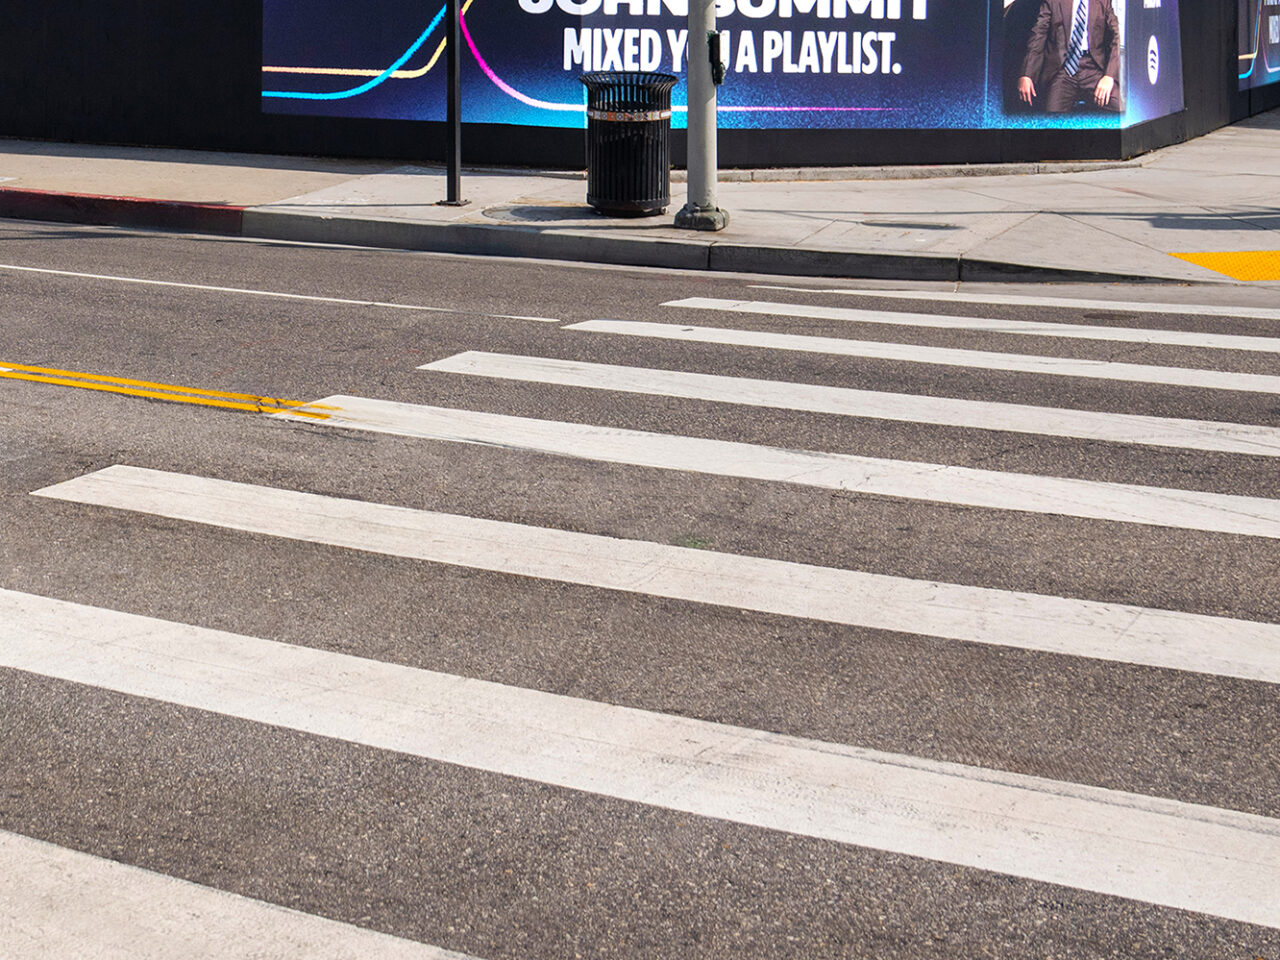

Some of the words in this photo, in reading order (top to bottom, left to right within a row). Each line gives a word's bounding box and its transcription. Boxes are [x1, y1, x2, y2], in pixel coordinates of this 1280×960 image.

[563, 27, 663, 73] MIXED
[666, 28, 730, 73] YU
[734, 29, 758, 73] A
[762, 29, 902, 74] PLAYLIST.
